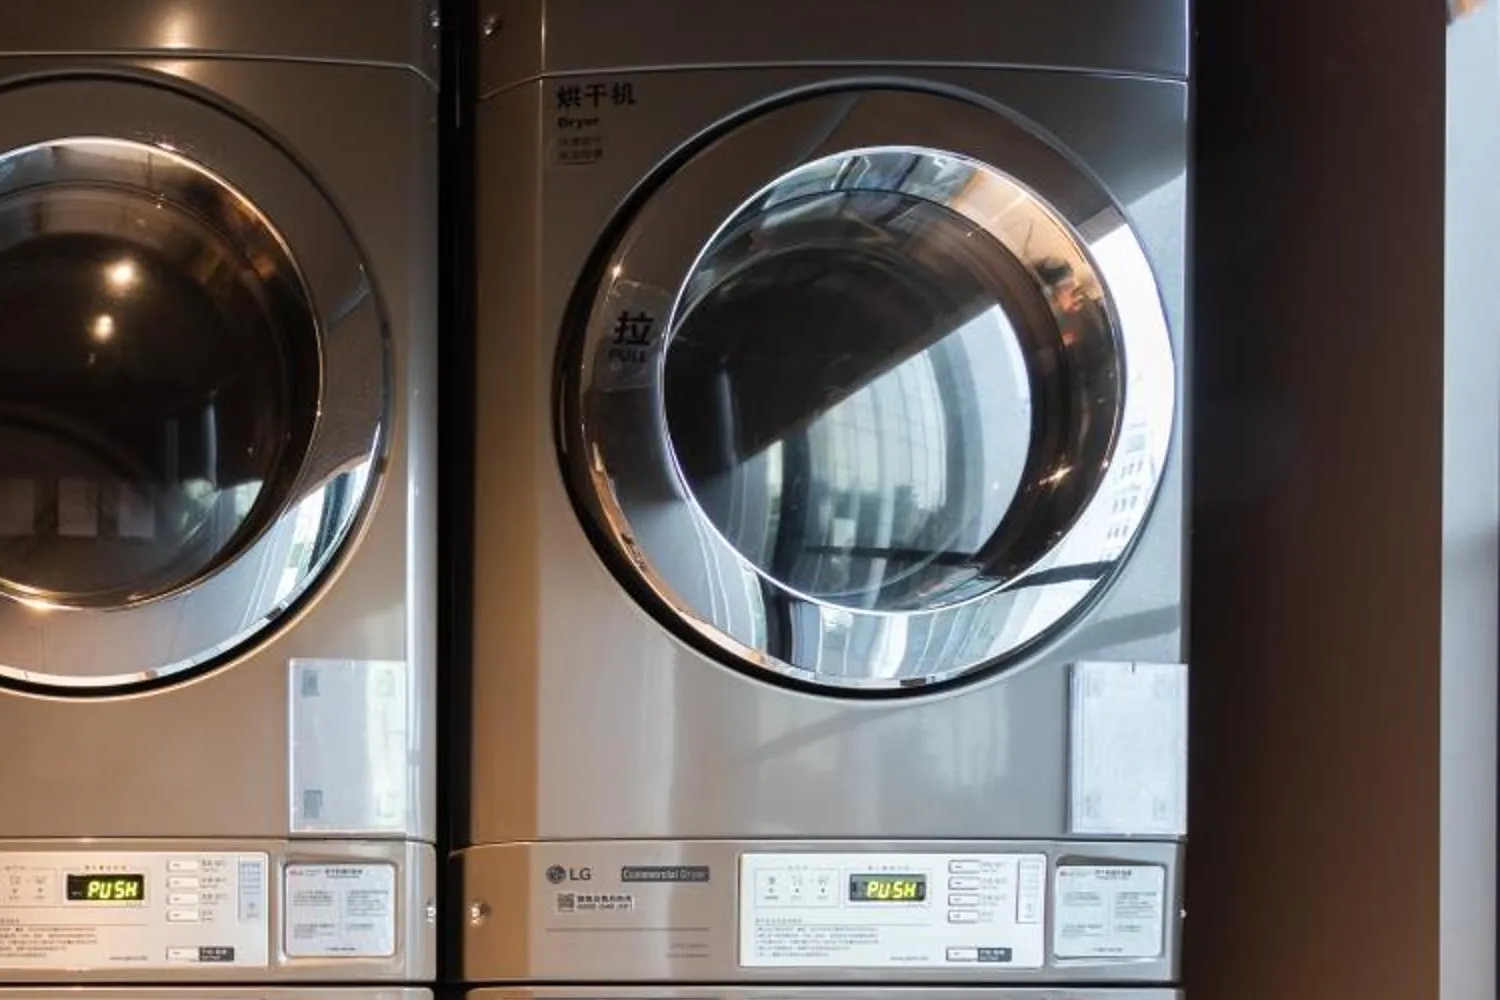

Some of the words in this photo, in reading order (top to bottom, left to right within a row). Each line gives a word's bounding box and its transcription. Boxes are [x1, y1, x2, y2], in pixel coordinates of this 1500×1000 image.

[557, 82, 637, 108] 烘干机
[557, 116, 599, 129] Dryer
[613, 311, 654, 345] 拉
[609, 347, 647, 362] PULL
[623, 867, 679, 880] Commercial
[87, 880, 138, 898] PUSH
[867, 880, 916, 898] PUSH
